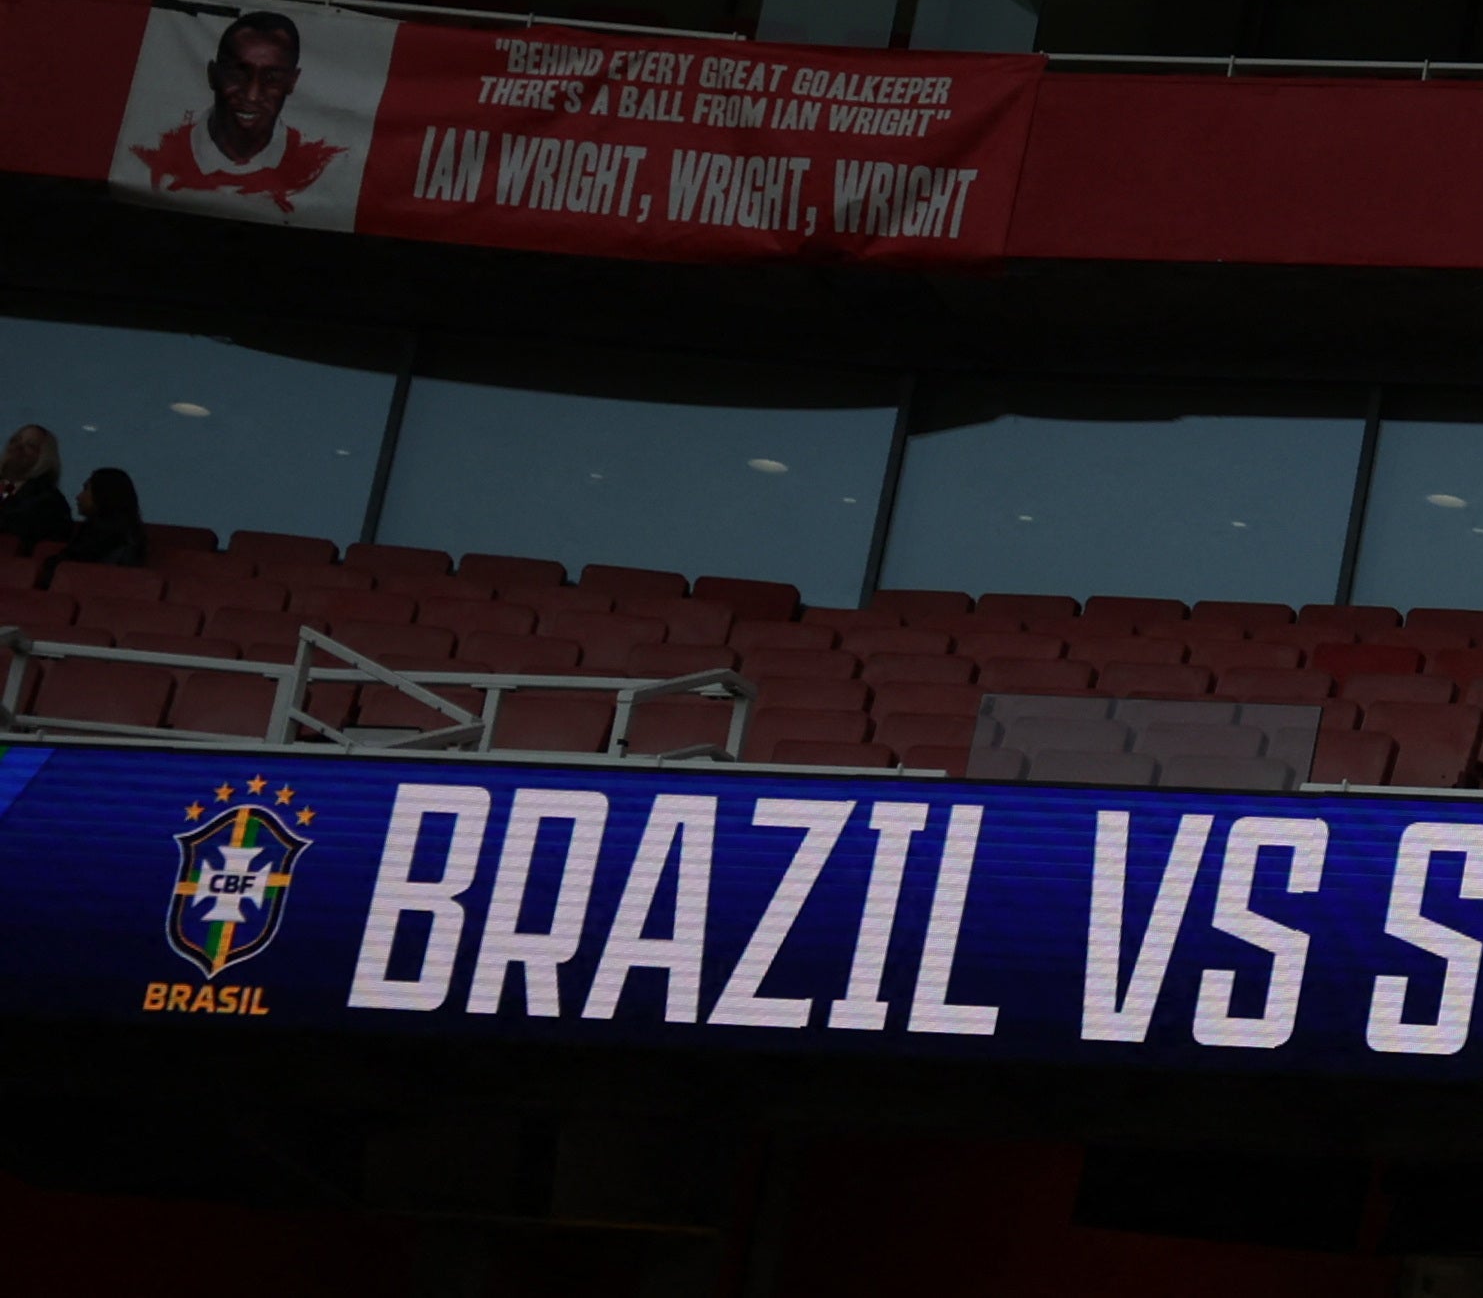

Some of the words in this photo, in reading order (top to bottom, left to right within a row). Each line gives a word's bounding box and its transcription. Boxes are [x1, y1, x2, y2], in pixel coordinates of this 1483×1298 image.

[495, 37, 605, 78] "BEHIND
[608, 49, 694, 86] EVERY
[699, 57, 787, 93] GREAT
[792, 67, 952, 105] GOALKEEPER
[478, 75, 585, 114] THERE'S
[589, 83, 610, 116] A
[617, 86, 685, 123] BALL
[692, 93, 768, 129] FROM
[770, 99, 820, 132] IAN
[827, 104, 952, 138] WRIGHT"
[413, 125, 490, 203] IAN
[496, 132, 652, 223] WRIGHT,
[667, 149, 818, 236] WRIGHT,
[832, 158, 978, 239] WRIGHT
[210, 875, 255, 894] CBF
[347, 782, 1000, 1037] BRAZIL
[1080, 810, 1329, 1050] VS
[142, 981, 271, 1017] BRASIL
